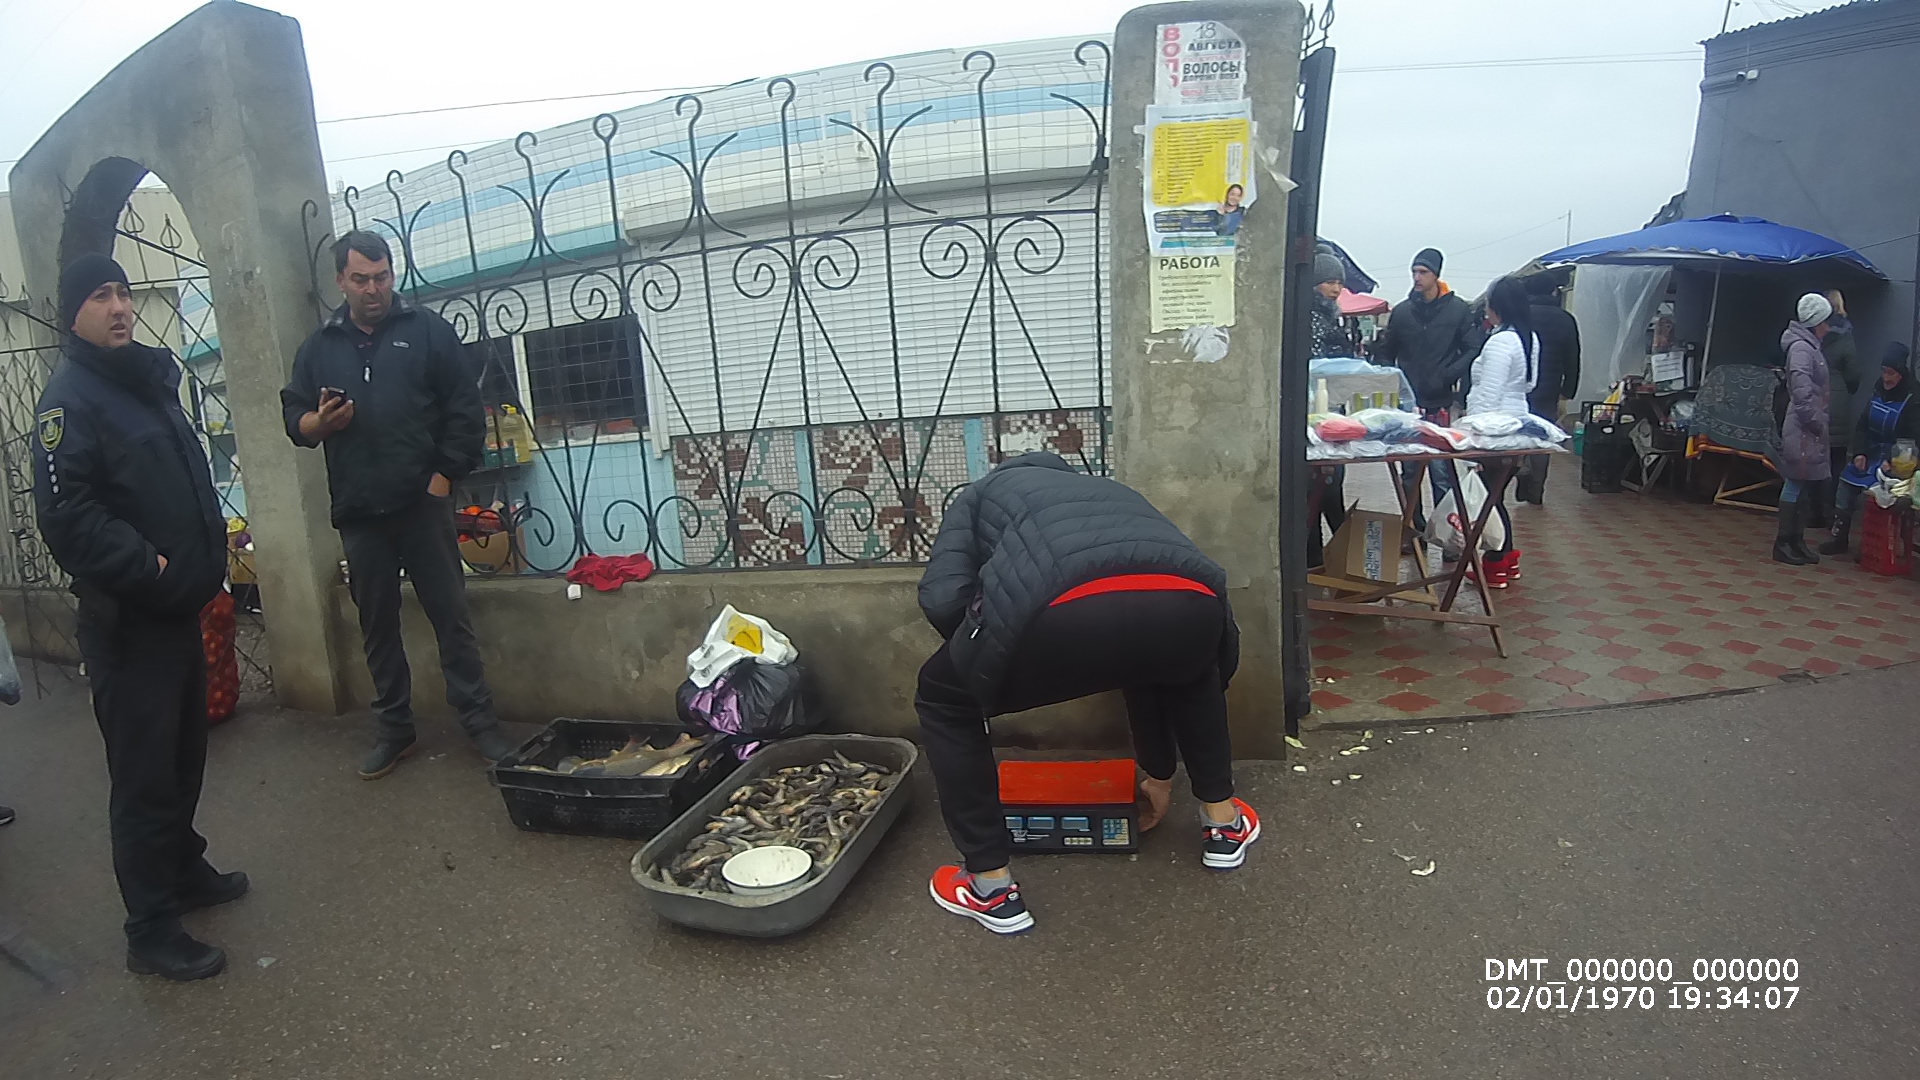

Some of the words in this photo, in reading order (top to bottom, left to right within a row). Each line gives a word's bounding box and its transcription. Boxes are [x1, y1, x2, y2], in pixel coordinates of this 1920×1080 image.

[1194, 22, 1217, 39] 18
[1187, 40, 1242, 52] АВГУСТА
[1183, 61, 1240, 75] ВОЛОСЫ
[1160, 256, 1220, 270] РАБОТА
